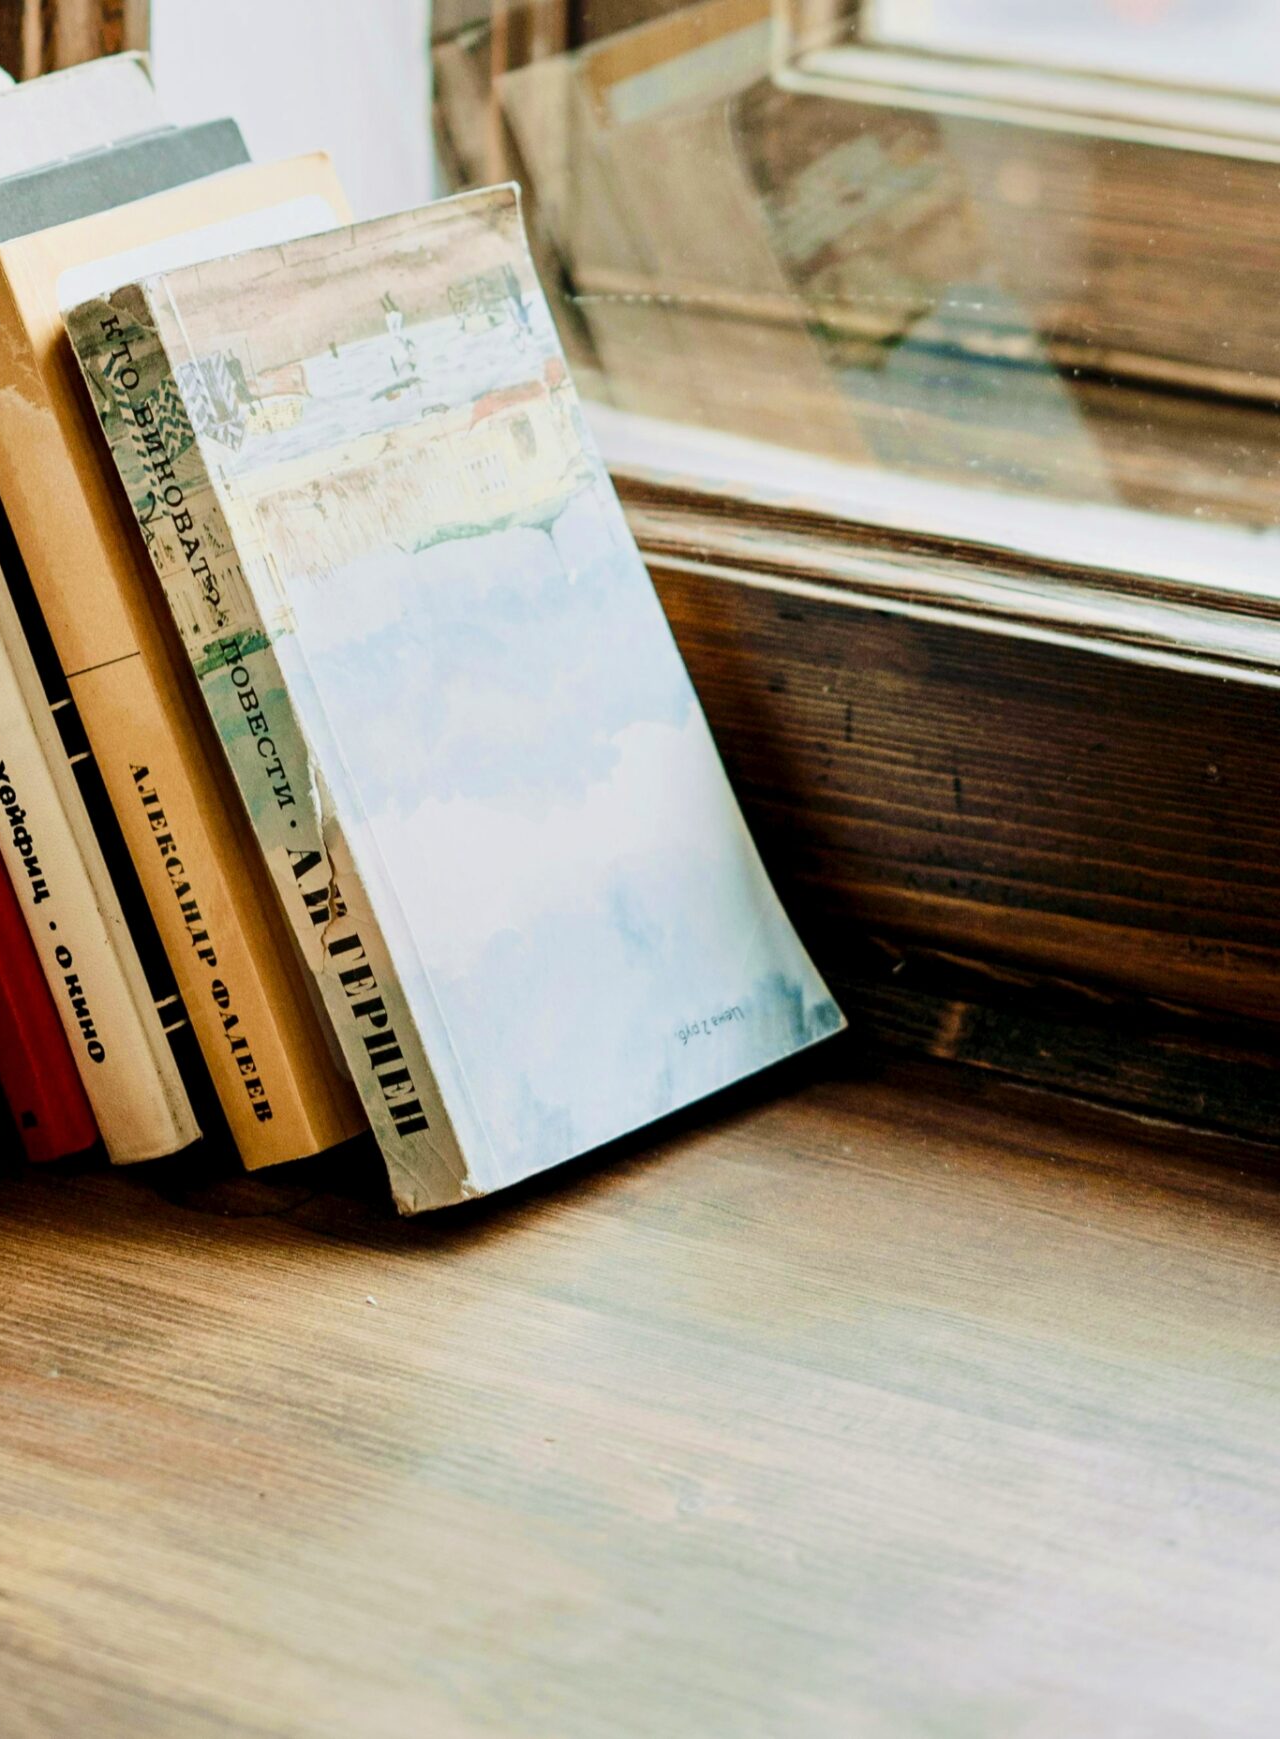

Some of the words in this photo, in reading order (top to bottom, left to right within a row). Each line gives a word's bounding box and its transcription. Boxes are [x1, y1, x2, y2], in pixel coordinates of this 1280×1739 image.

[100, 315, 140, 391] КТО
[219, 640, 296, 810] ПОВЕСТИ
[328, 932, 430, 1138] ГЕРЦЕН
[128, 763, 220, 967] АЛЕКСАНДР
[211, 979, 274, 1124] ФАДЕЕВ
